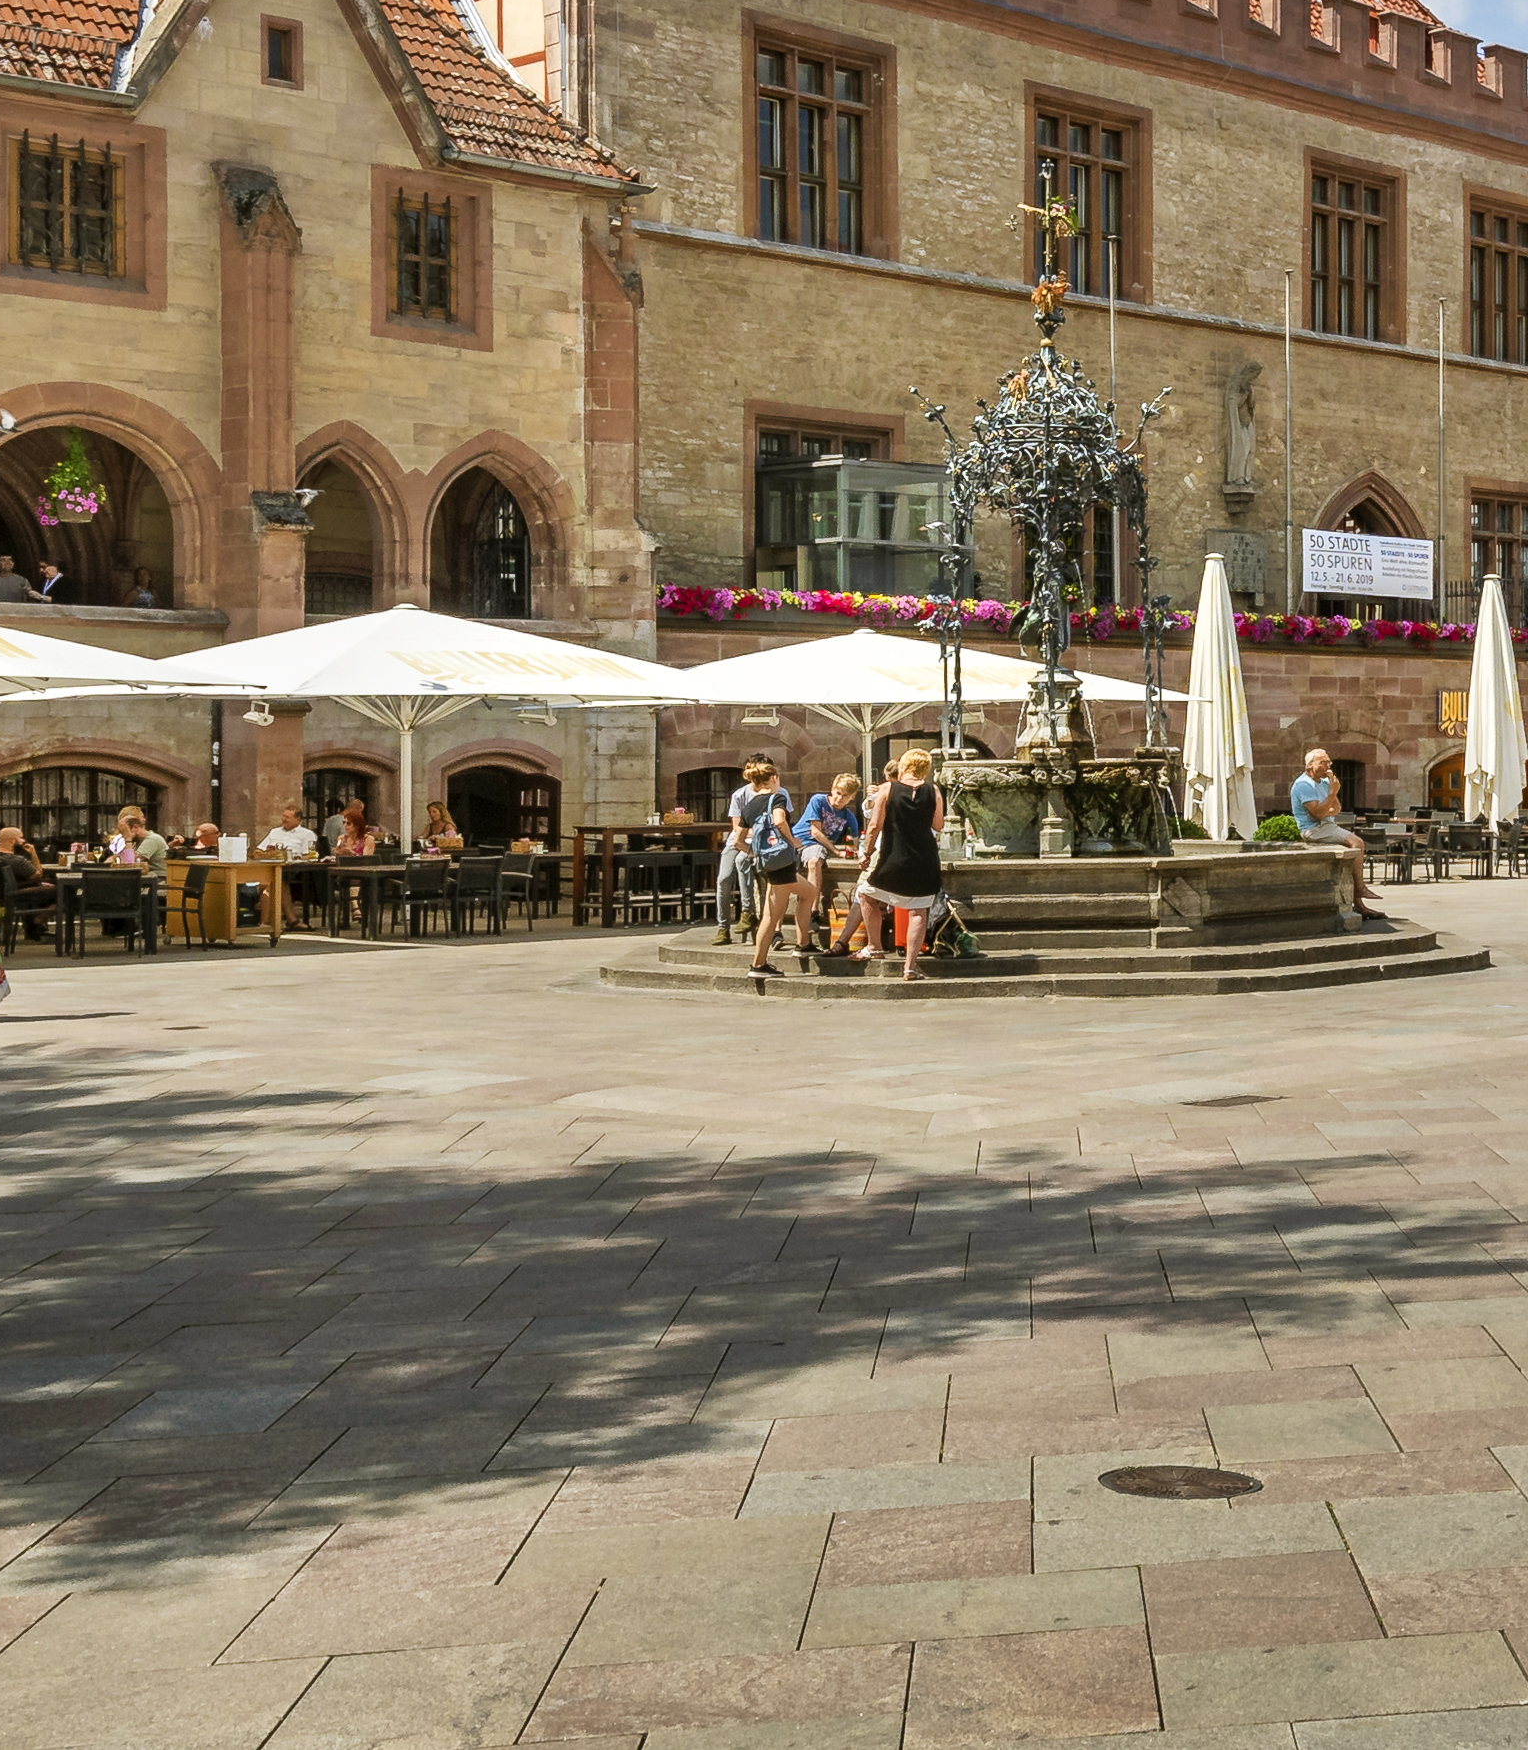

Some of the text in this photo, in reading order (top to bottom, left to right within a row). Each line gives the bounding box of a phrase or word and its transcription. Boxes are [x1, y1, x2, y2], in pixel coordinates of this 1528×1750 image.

[1310, 534, 1325, 549] 50
[1310, 553, 1373, 571] 50 SPUREN
[1442, 691, 1468, 721] BULL
